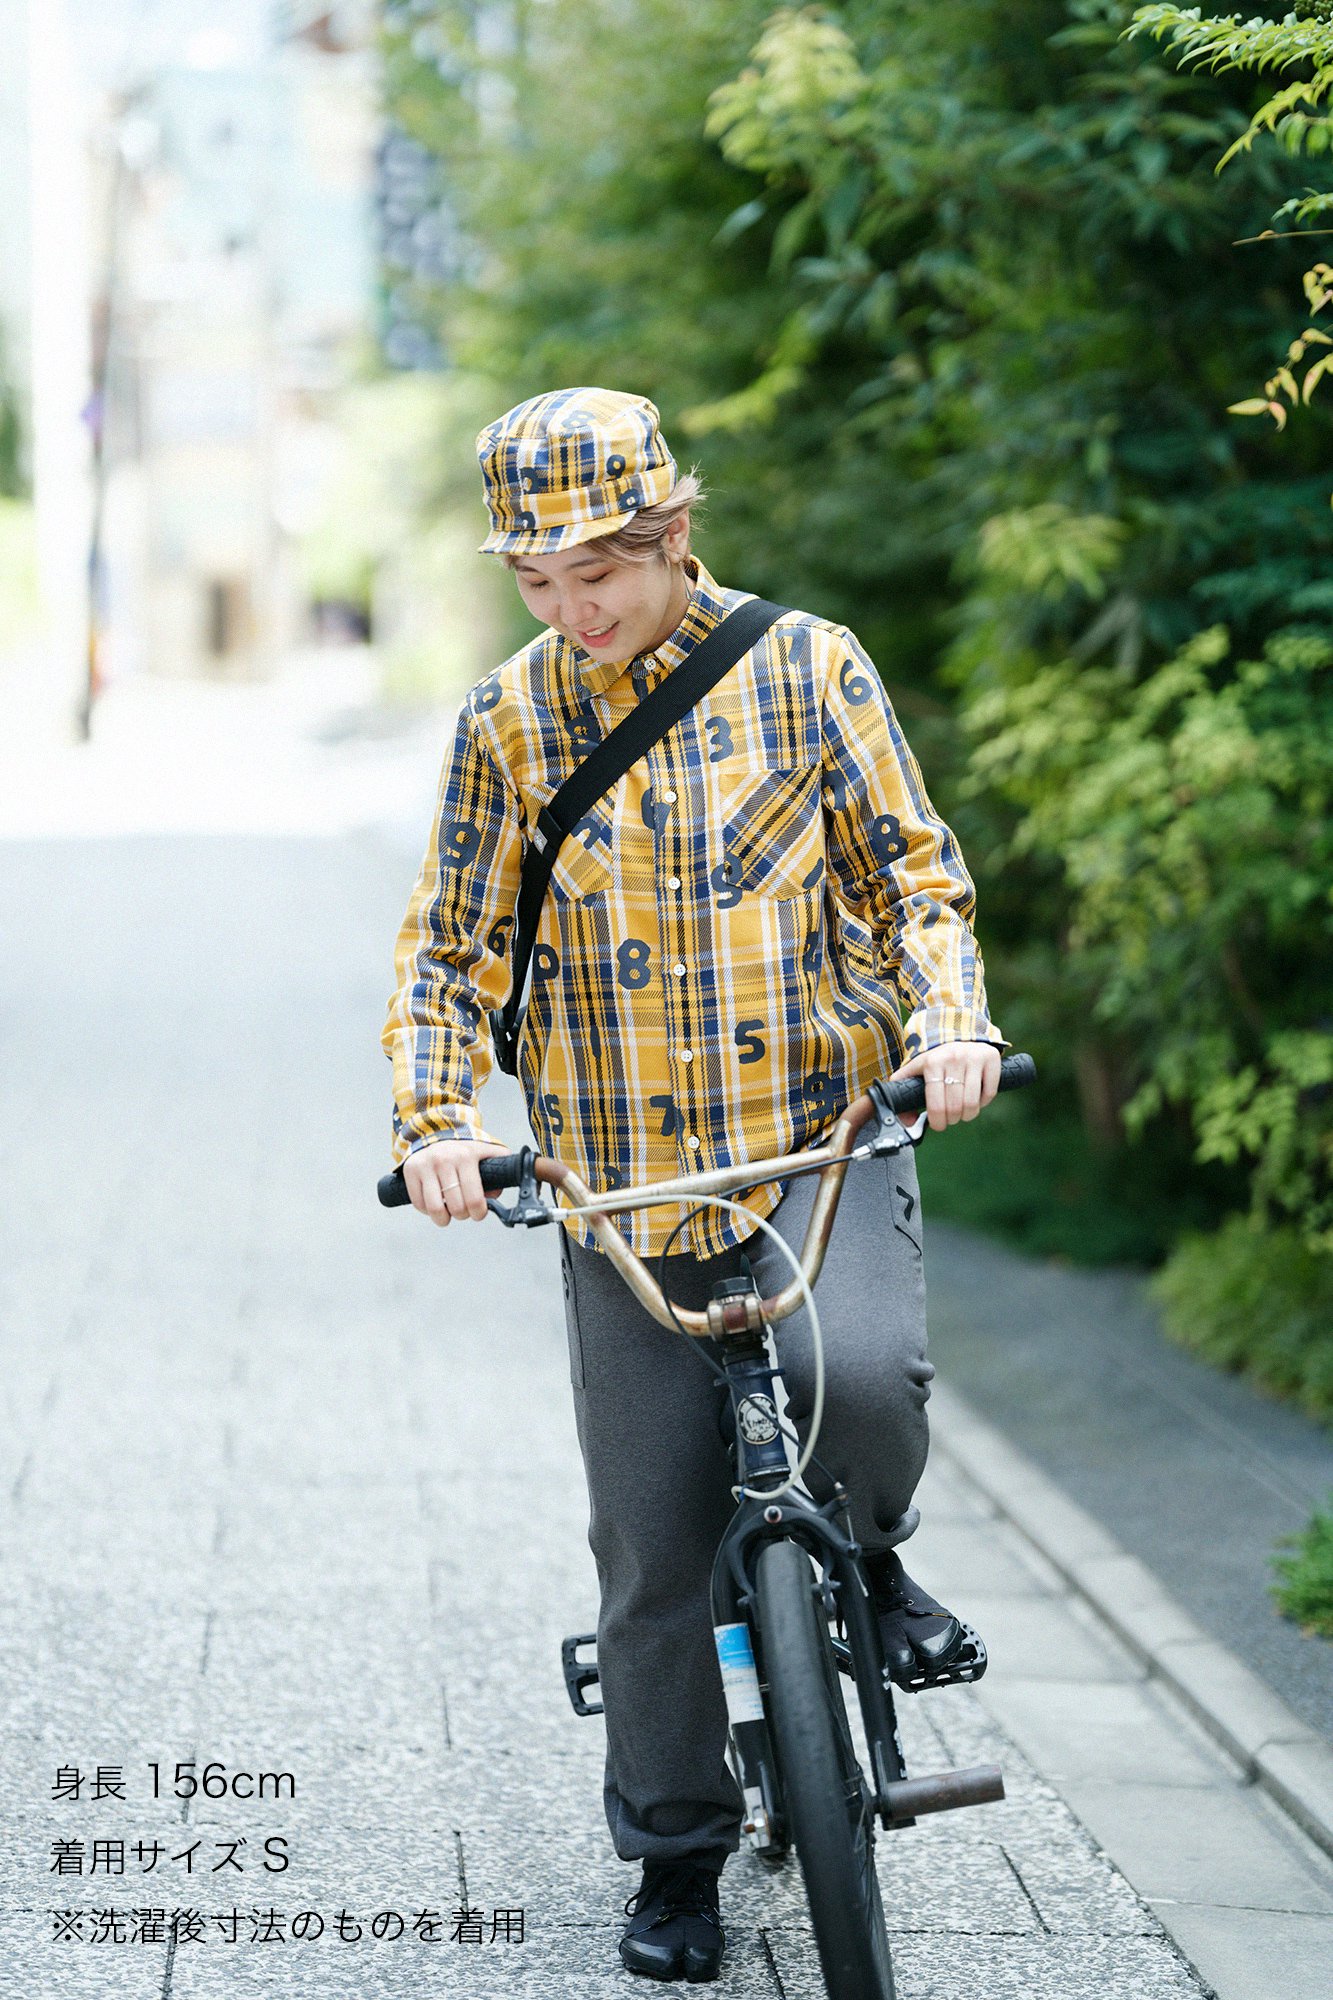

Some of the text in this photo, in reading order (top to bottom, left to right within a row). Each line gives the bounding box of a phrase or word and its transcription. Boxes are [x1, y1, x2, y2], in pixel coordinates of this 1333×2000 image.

[775, 627, 806, 665] 7
[839, 658, 873, 707] 6
[705, 716, 734, 763] 3
[870, 813, 909, 865] 8
[487, 915, 513, 958] 6
[616, 938, 652, 990] 8
[832, 1001, 871, 1030] 4
[734, 1019, 766, 1065] 5
[649, 1094, 686, 1137] 7
